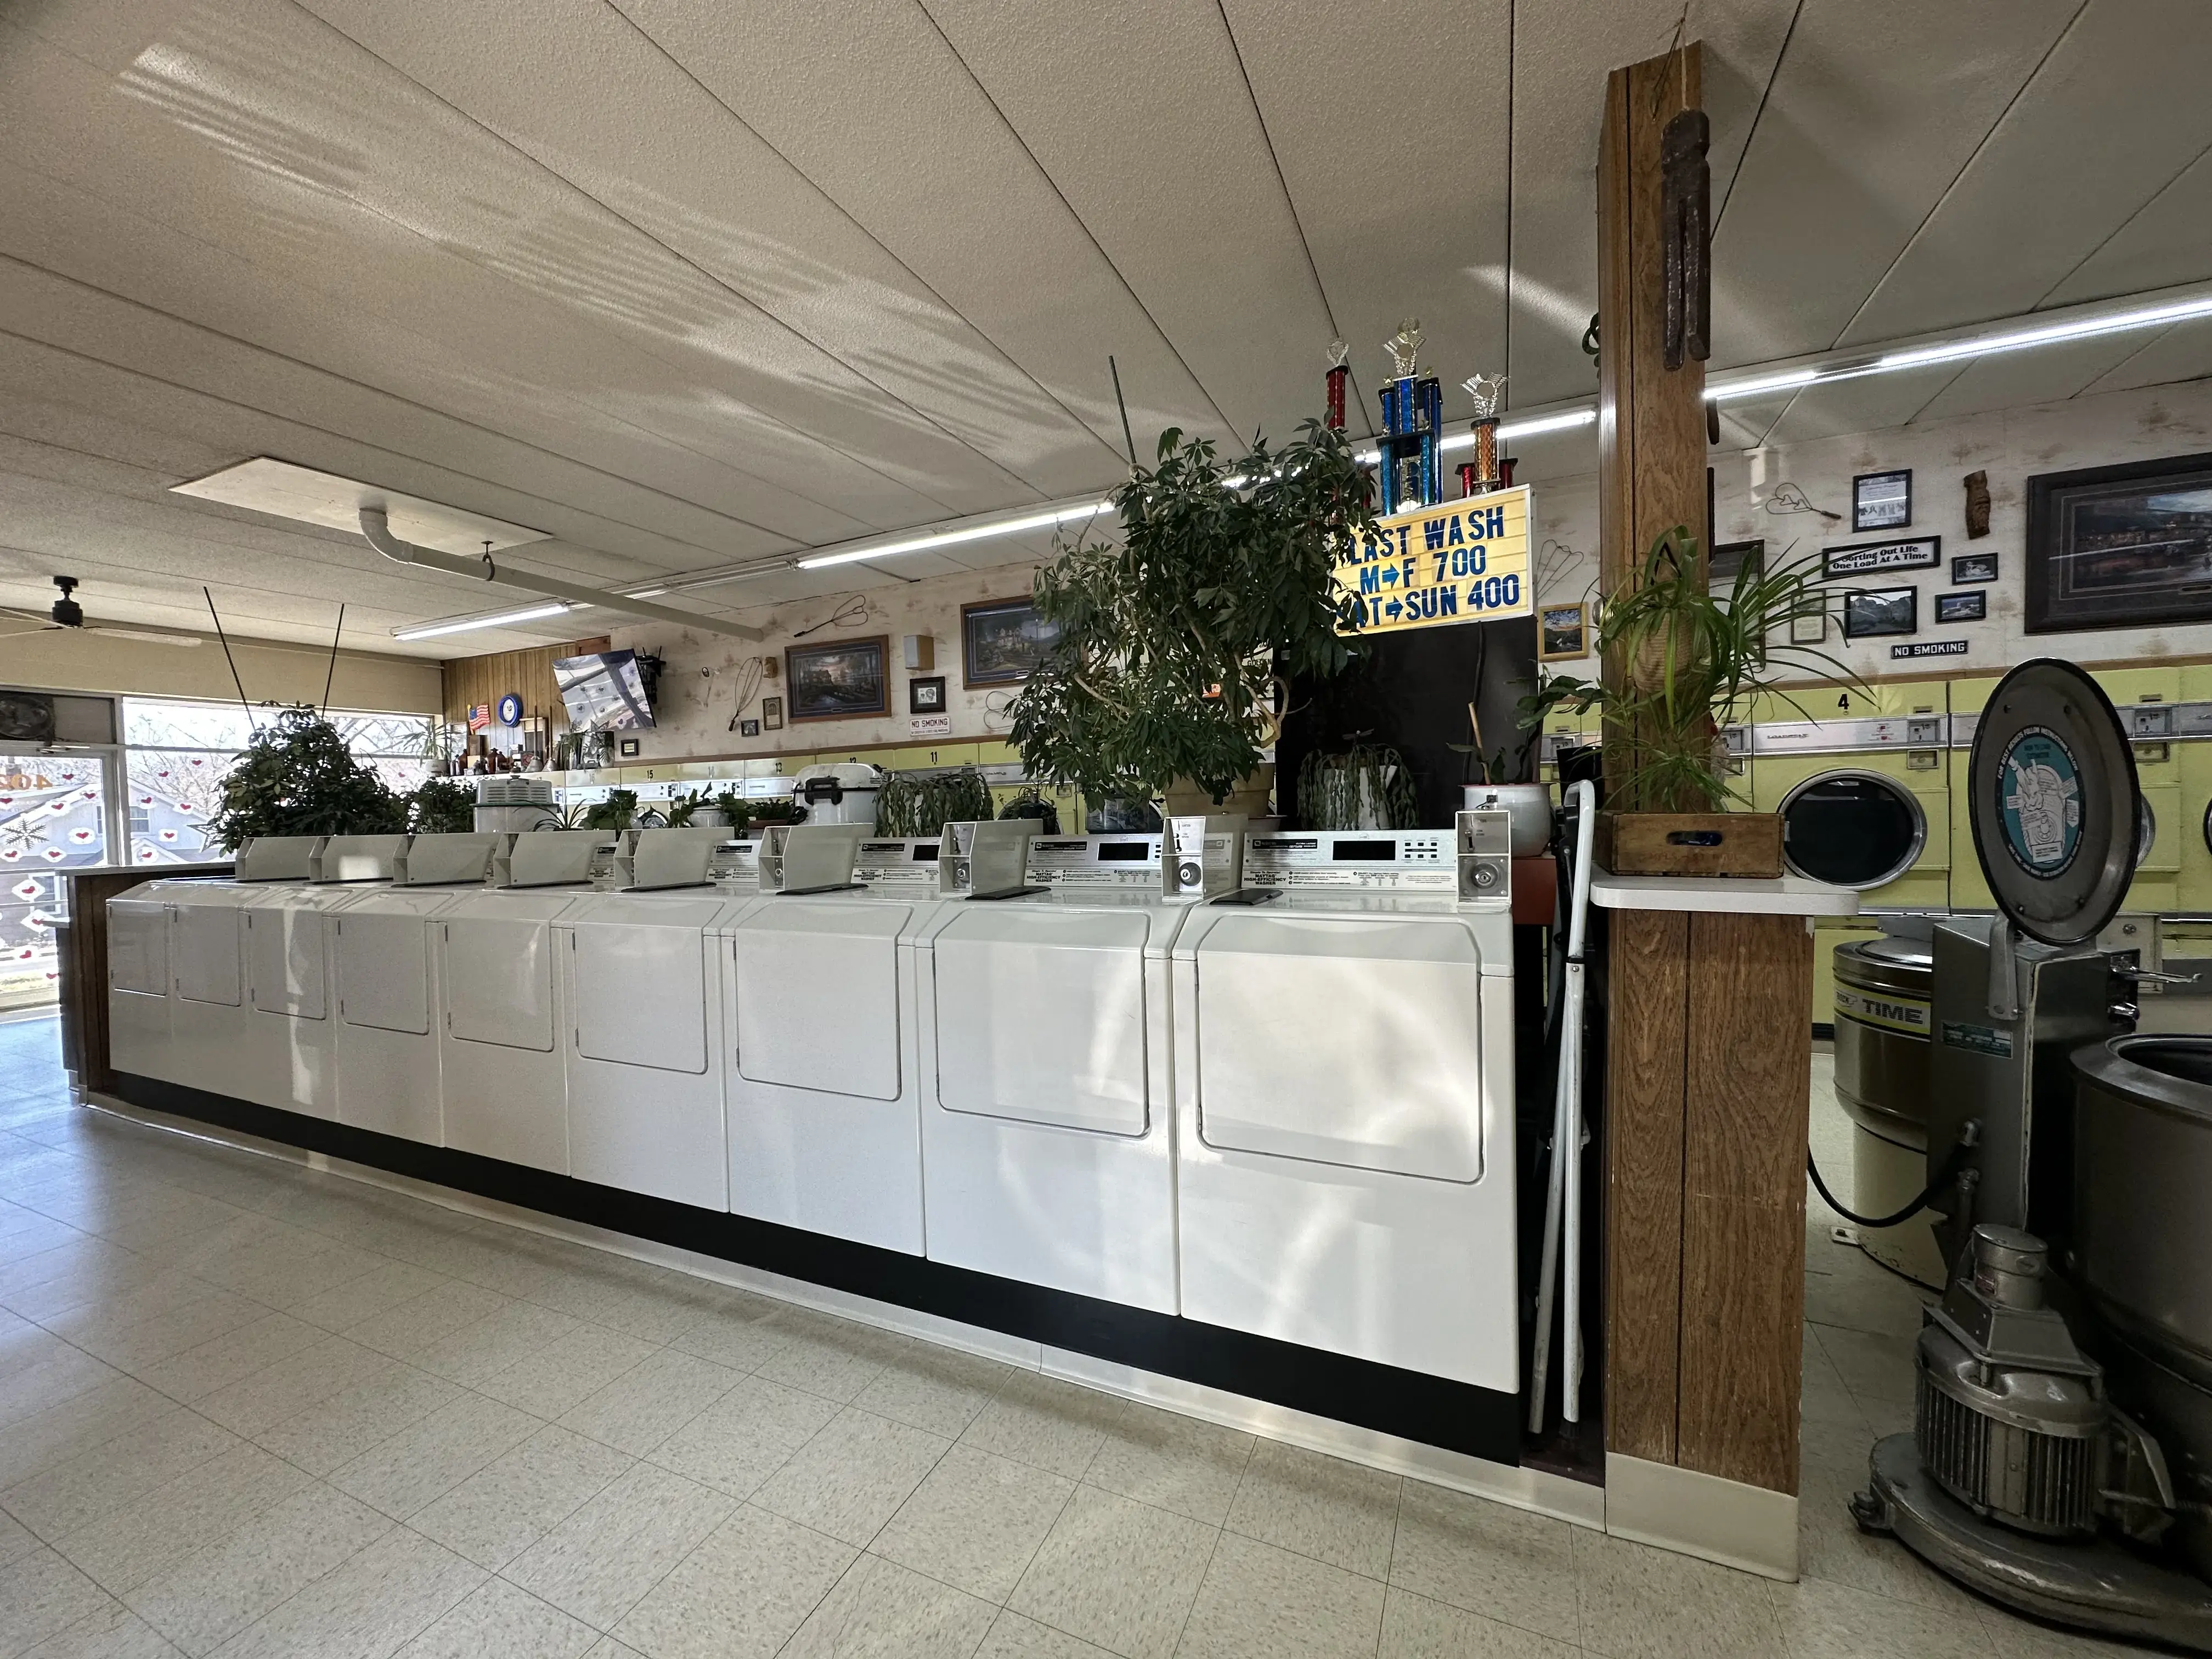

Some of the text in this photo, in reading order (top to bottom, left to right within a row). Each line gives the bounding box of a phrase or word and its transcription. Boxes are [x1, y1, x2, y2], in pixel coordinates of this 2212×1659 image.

[1350, 506, 1504, 565] LAST WASH
[1880, 548, 1897, 556] Out
[1432, 545, 1486, 582] 700
[1854, 559, 1877, 568] Load
[1337, 574, 1520, 628] AT SUN 400
[1894, 642, 1965, 656] NO SMOKING
[1838, 693, 1849, 709] 4
[911, 718, 948, 729] NO SMOKING
[930, 751, 938, 763] 11
[775, 762, 782, 772] 13
[646, 769, 653, 780] 15
[1862, 998, 1923, 1024] TIME
